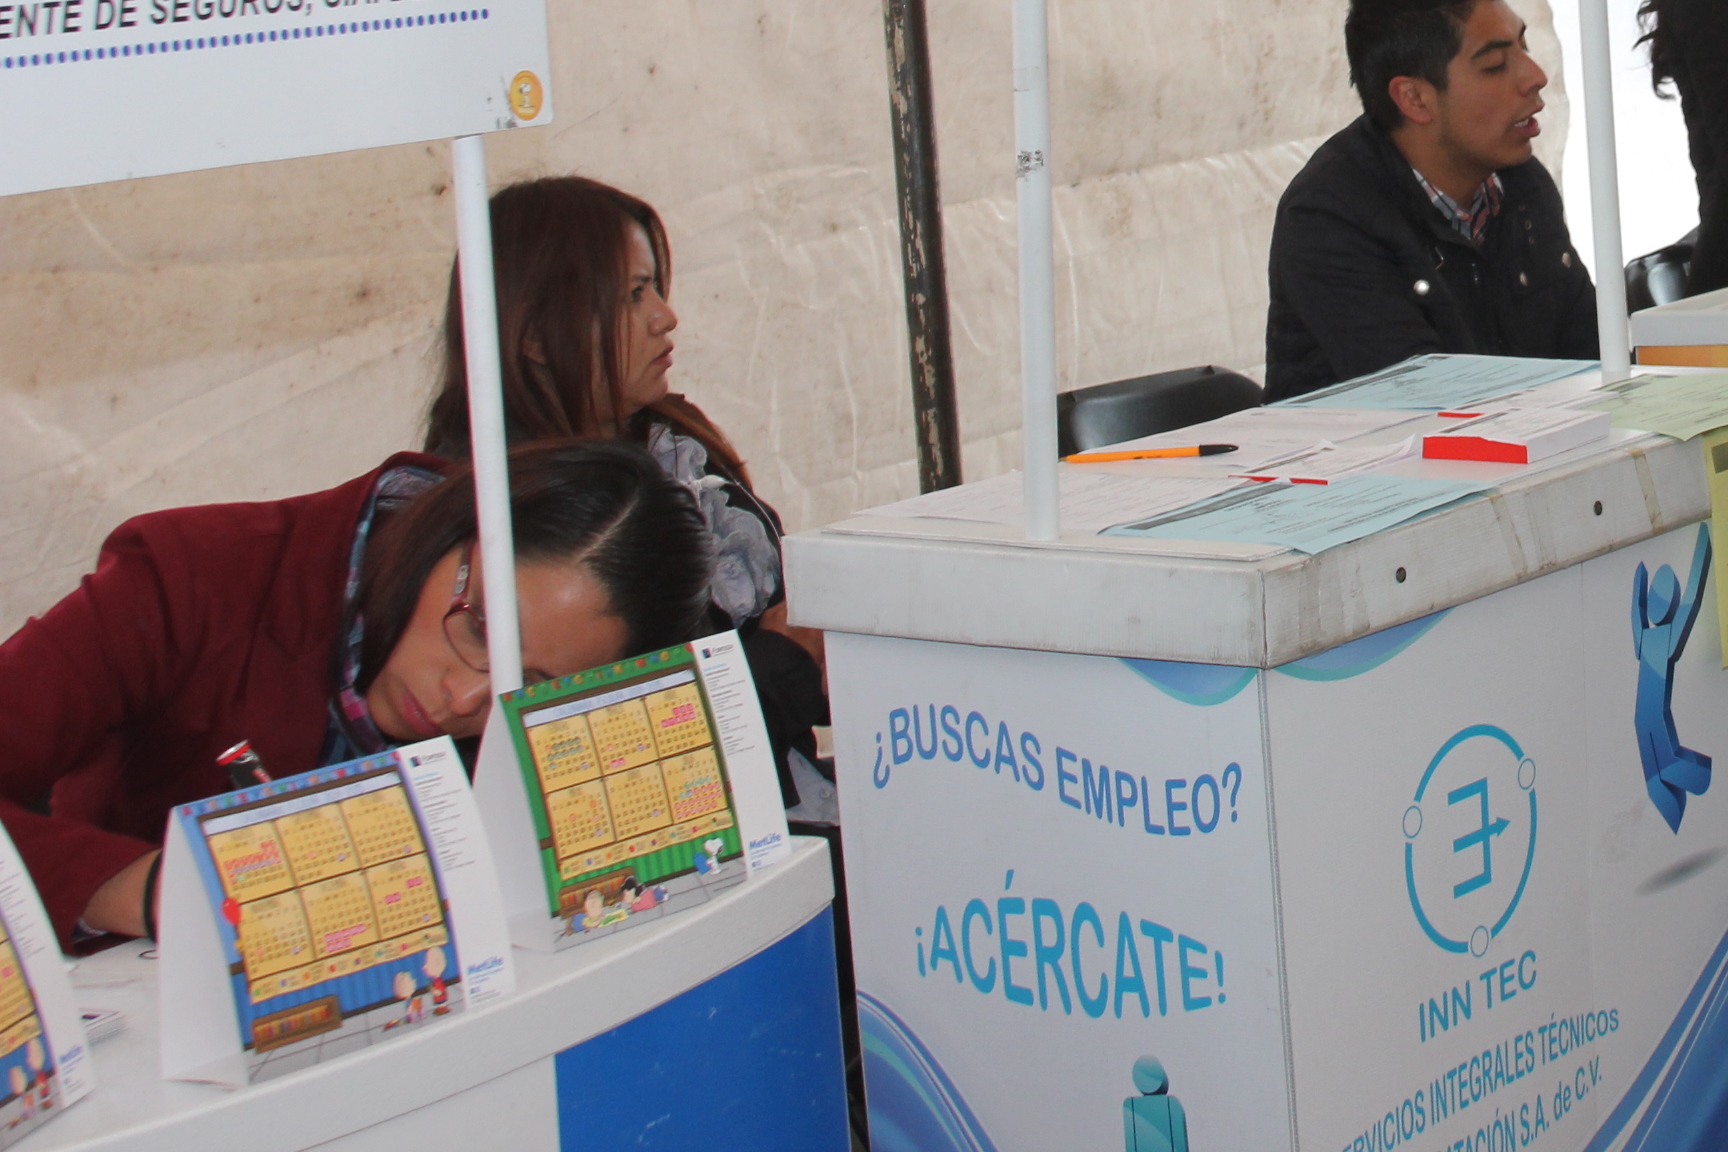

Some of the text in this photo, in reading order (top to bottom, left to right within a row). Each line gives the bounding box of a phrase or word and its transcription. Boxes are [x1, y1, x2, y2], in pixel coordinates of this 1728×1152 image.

[873, 703, 1243, 837] ¿BUSCAS EMPLEO?
[915, 869, 1227, 1019] ¡ACÉRCATE!
[1418, 949, 1538, 1043] INN TEC
[1429, 1030, 1535, 1126] INTEGRALES
[1538, 1008, 1619, 1065] TÉCNICOS
[1520, 1094, 1550, 1148] S.A.
[1554, 1081, 1572, 1121] de
[1575, 1055, 1602, 1100] C.V.
